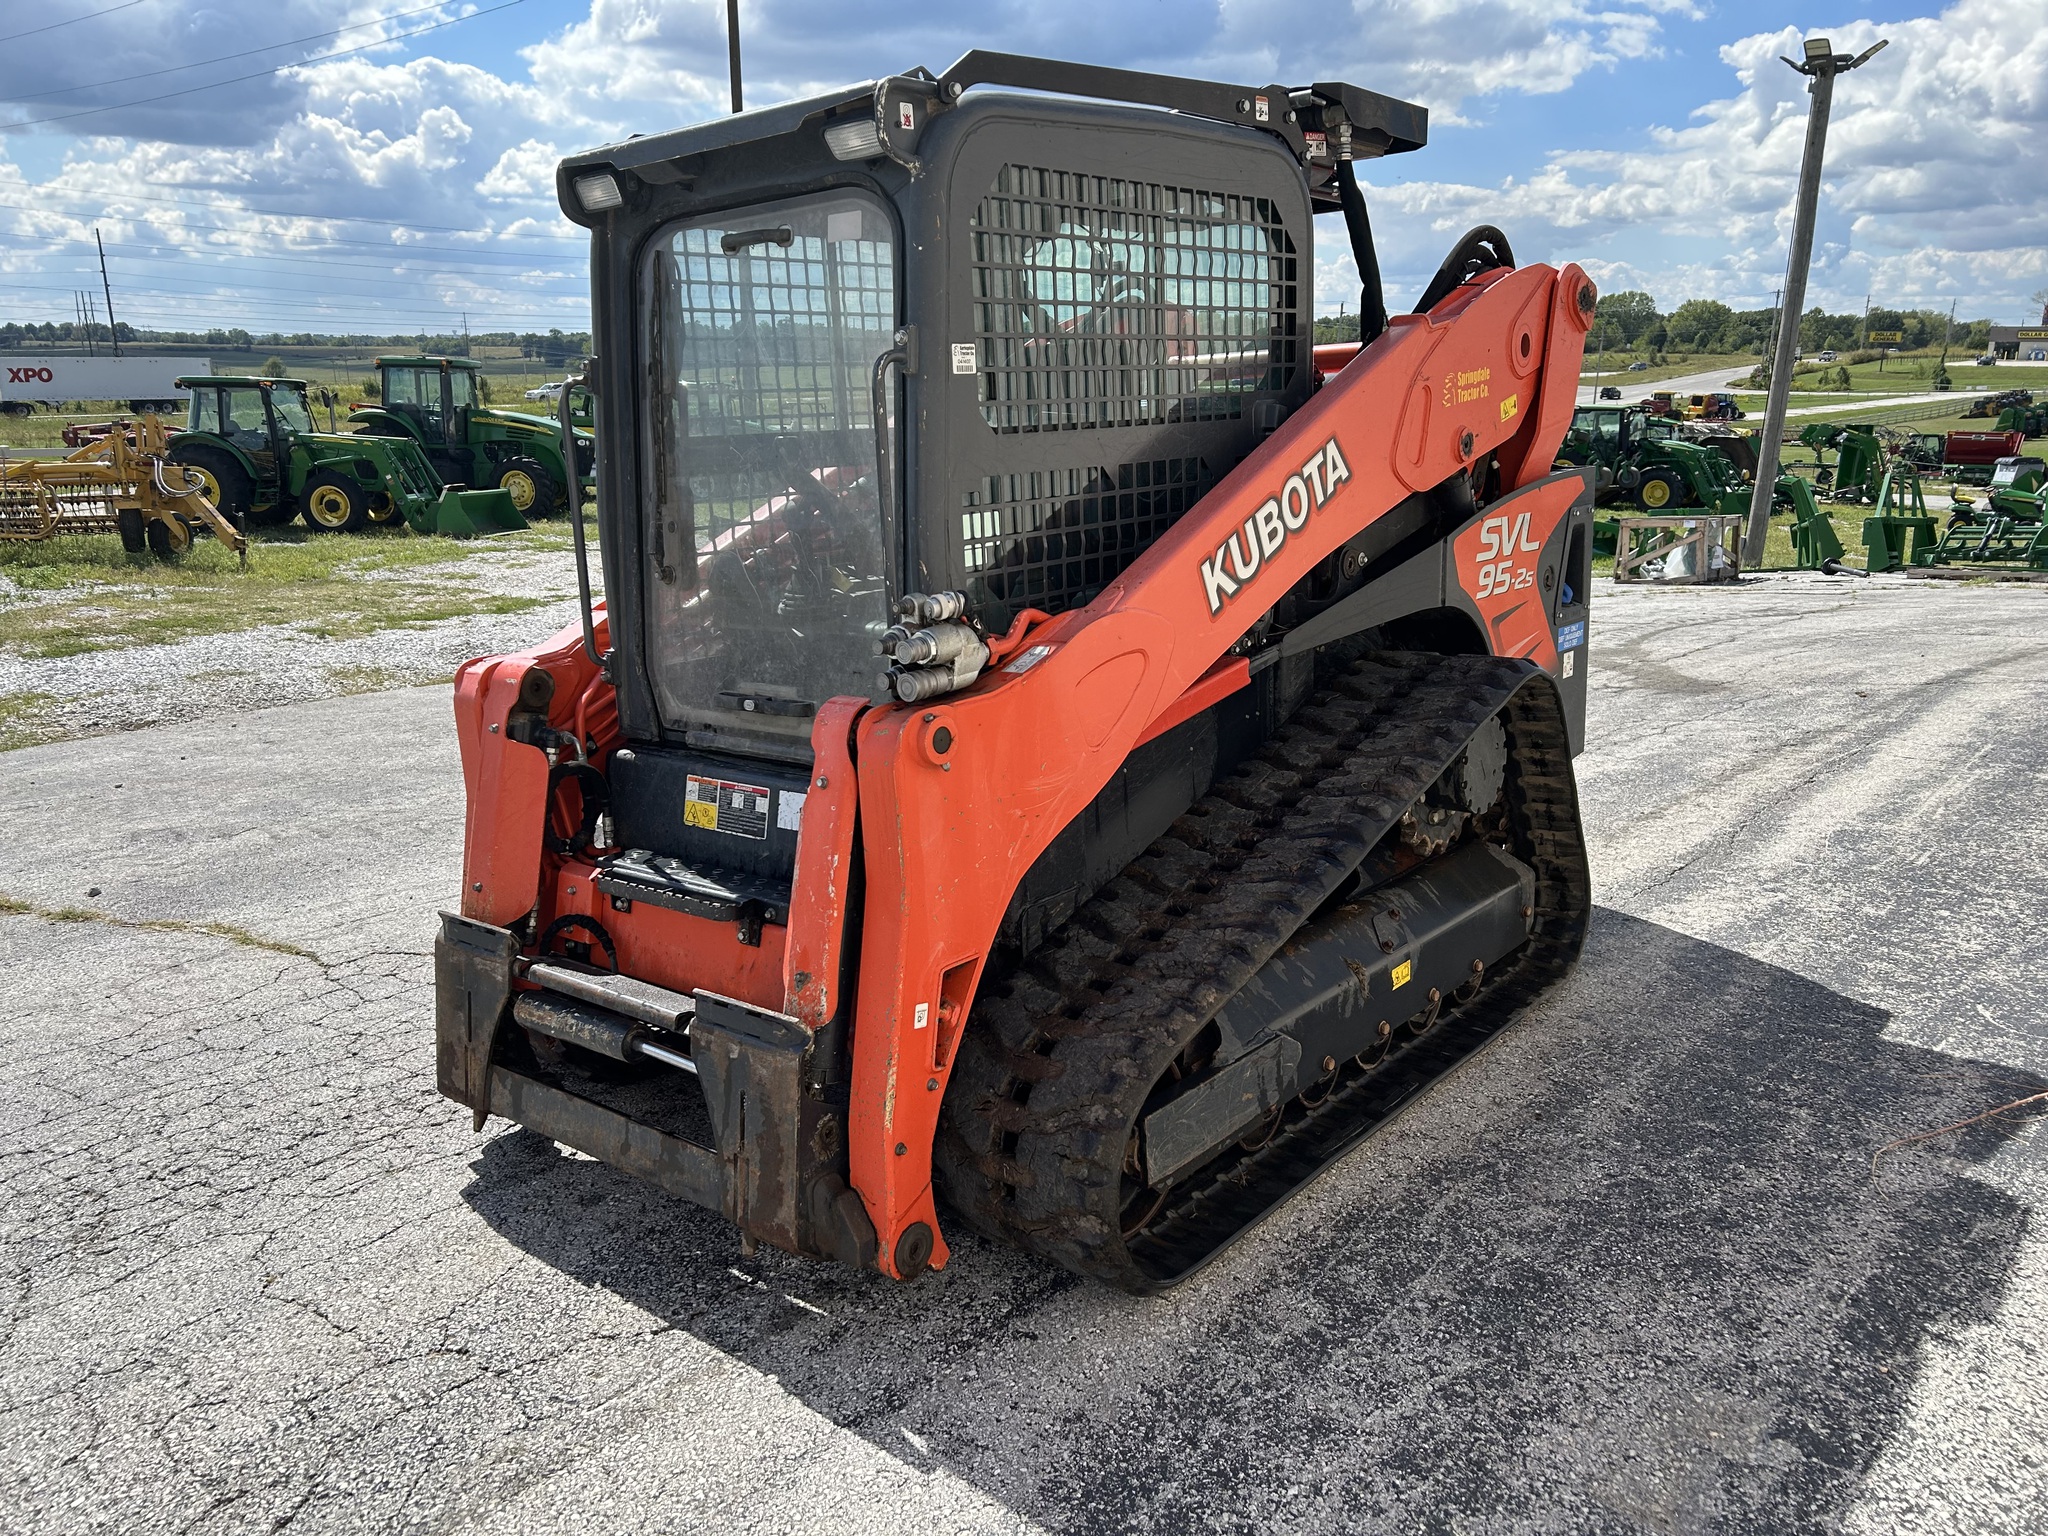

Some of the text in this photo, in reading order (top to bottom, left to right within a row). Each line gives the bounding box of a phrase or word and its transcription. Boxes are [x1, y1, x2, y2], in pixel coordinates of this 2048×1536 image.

[6, 367, 53, 383] XPO
[1457, 366, 1490, 387] Springdale
[1457, 383, 1490, 403] Tractor Co.
[1200, 438, 1350, 614] KUBOTA
[1475, 512, 1541, 563] SVL
